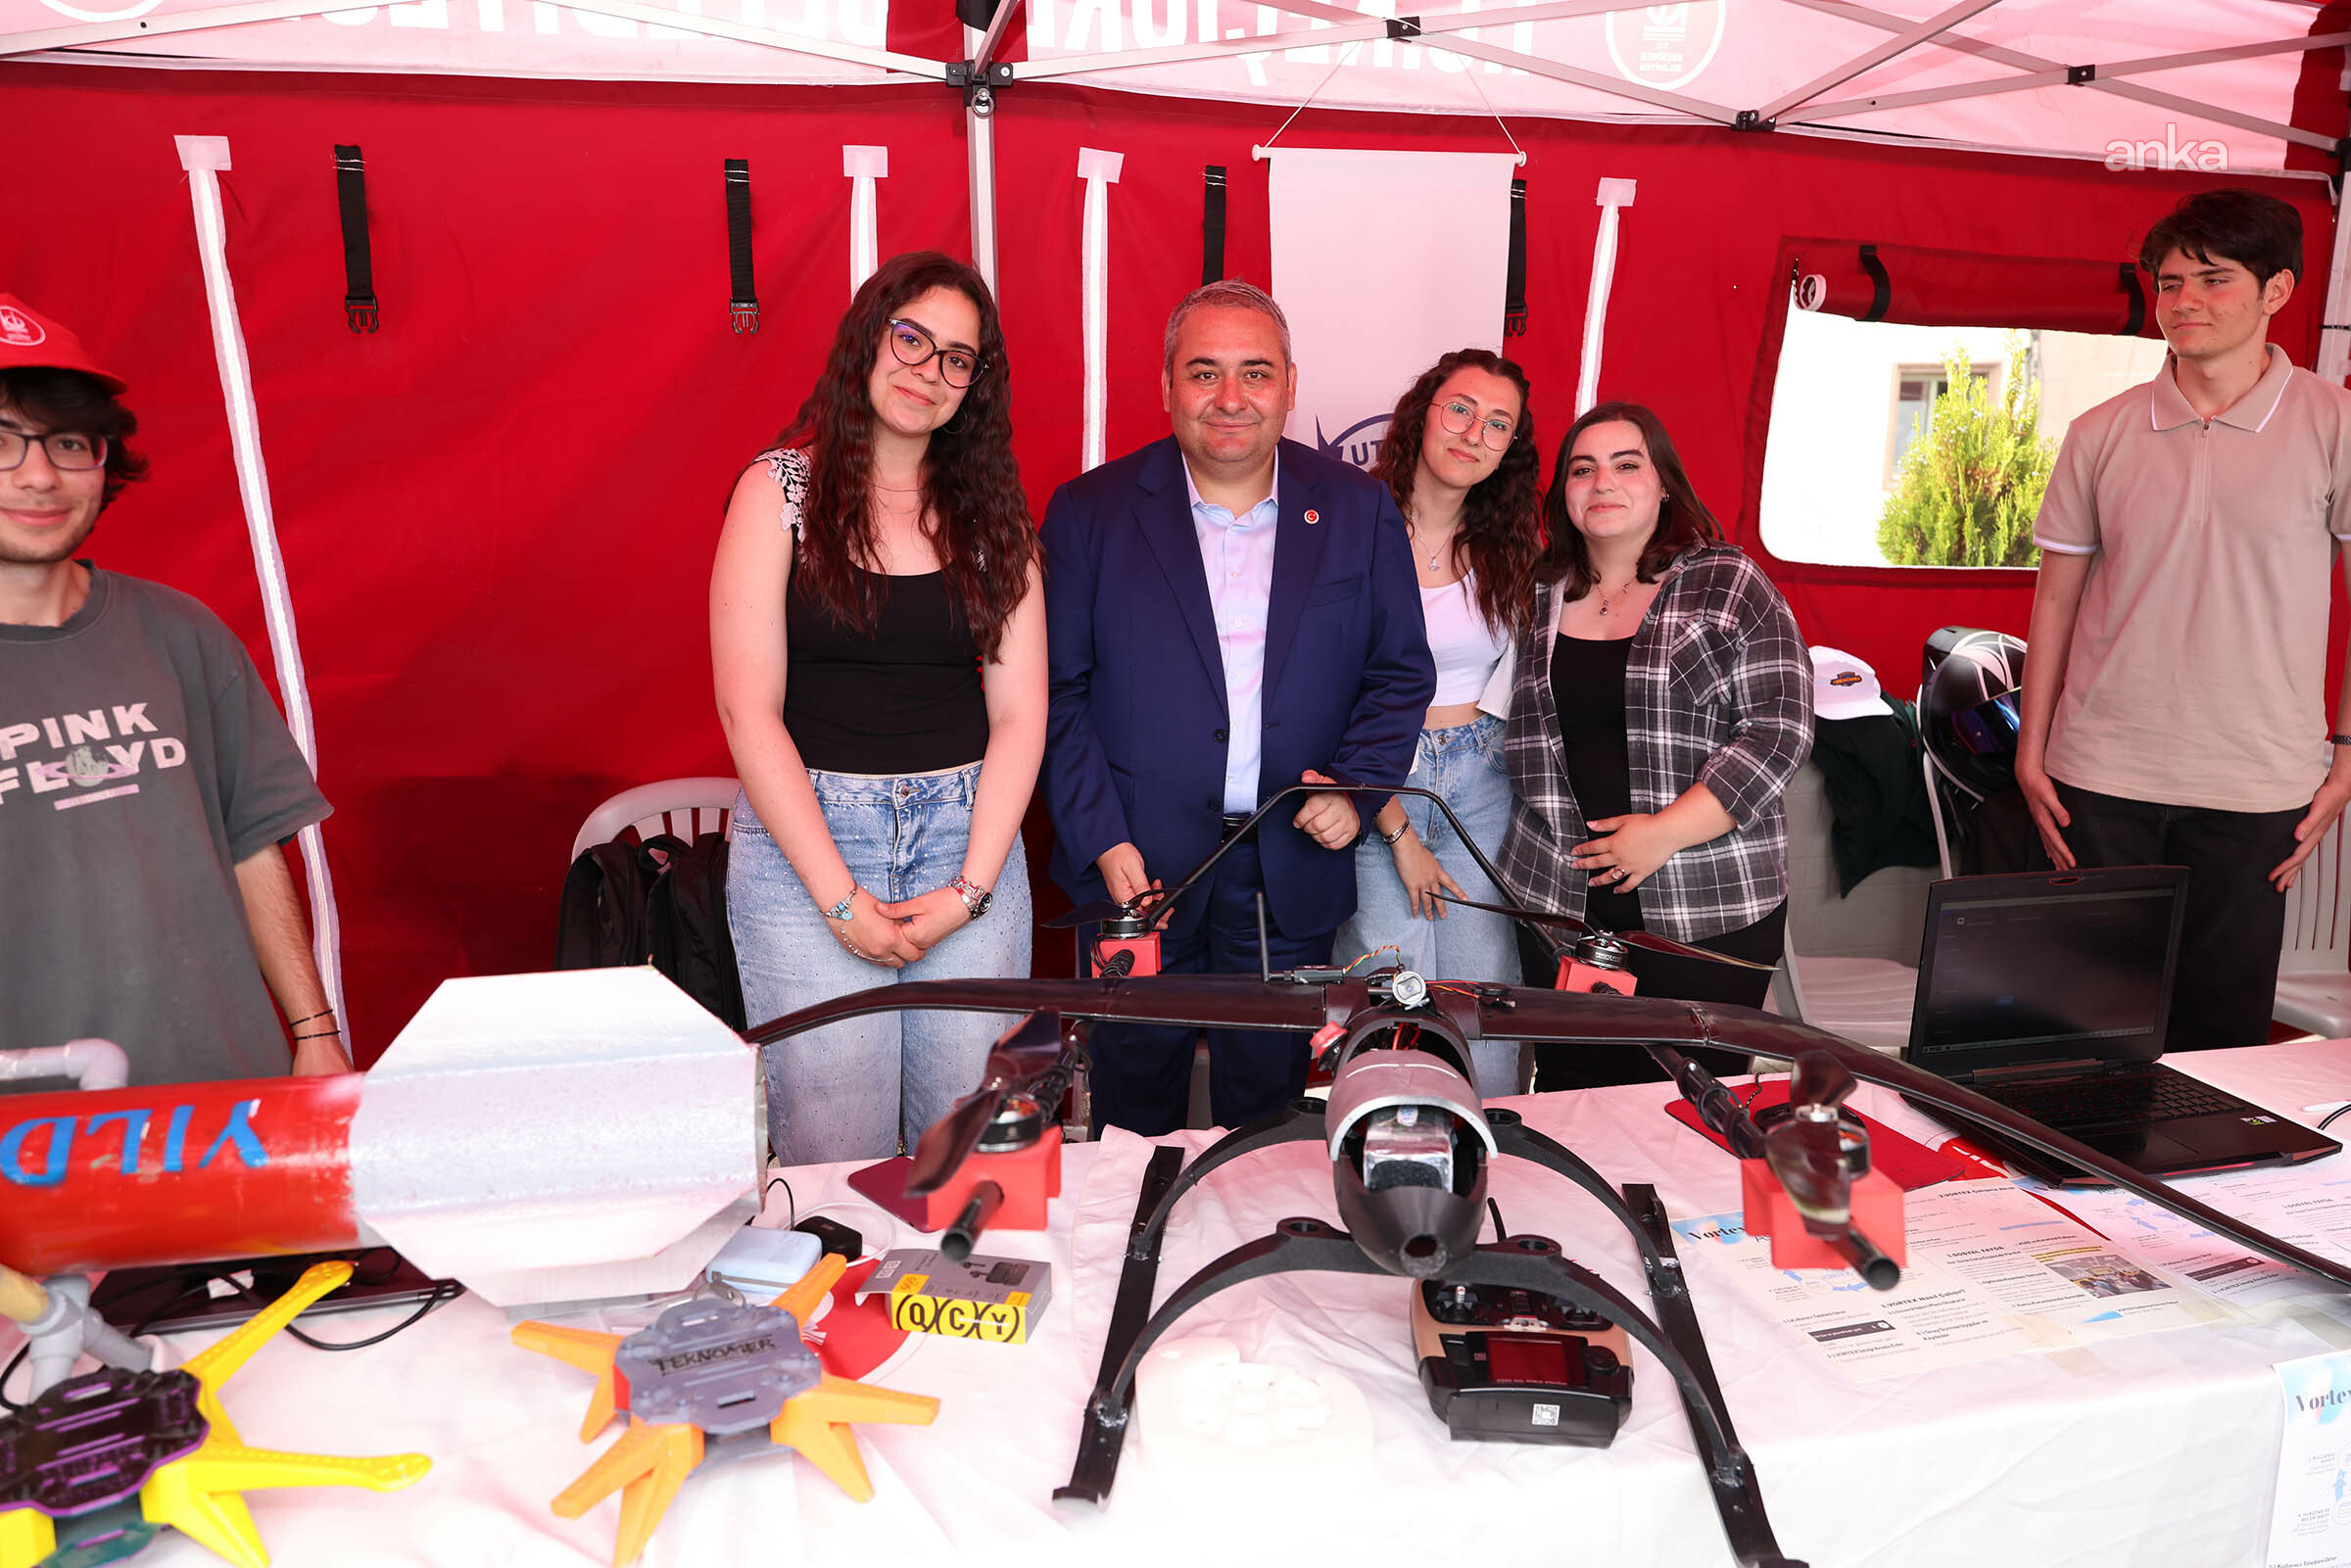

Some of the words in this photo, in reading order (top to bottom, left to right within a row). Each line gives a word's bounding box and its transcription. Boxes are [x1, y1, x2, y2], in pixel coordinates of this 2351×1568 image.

[0, 702, 159, 761] PINK
[908, 1302, 1009, 1336] QCY
[649, 1336, 777, 1374] TEKNOMER
